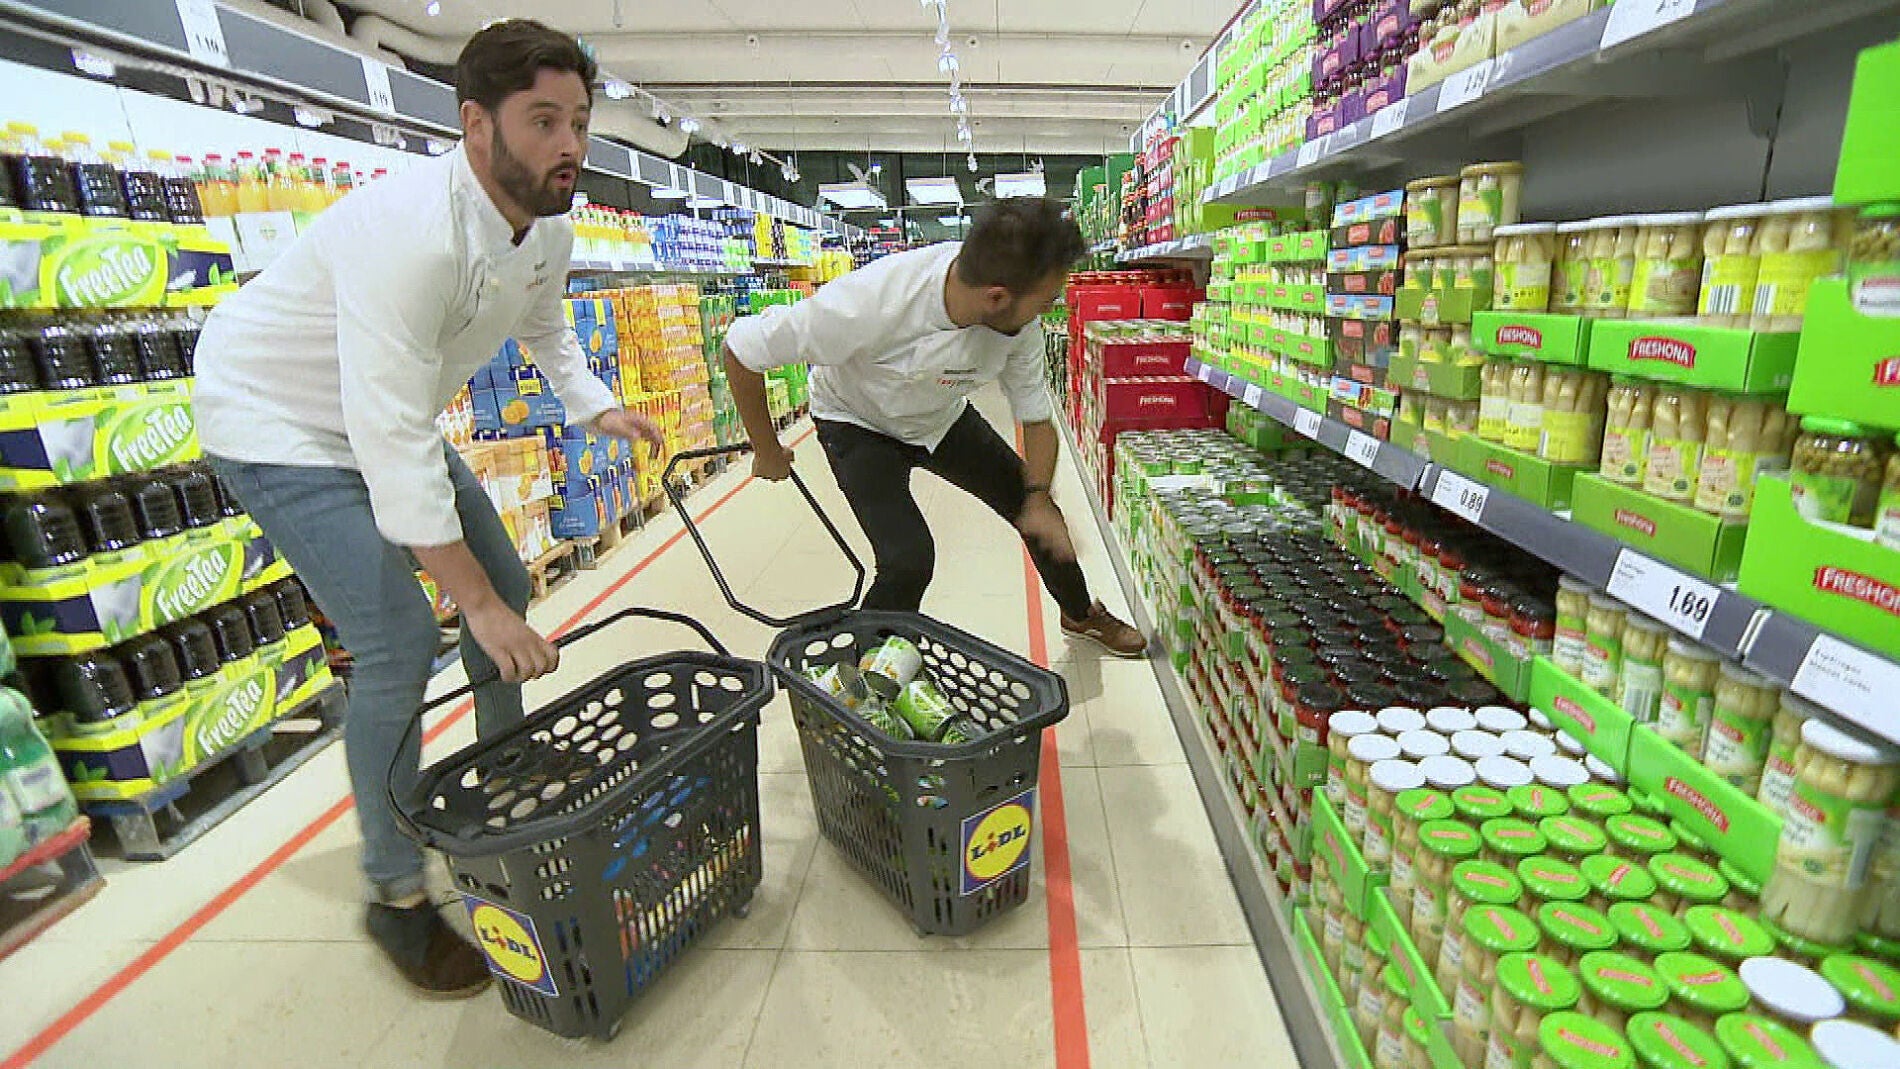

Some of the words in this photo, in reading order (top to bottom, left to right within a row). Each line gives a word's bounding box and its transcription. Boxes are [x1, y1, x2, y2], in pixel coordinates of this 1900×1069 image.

[59, 244, 151, 307] FreeTea
[1498, 326, 1538, 348] FRESHONA
[1632, 339, 1690, 366] FRESHONA
[112, 404, 192, 473] FreeTea
[1460, 488, 1484, 513] 0.89
[155, 547, 229, 621] FreeTea
[1669, 585, 1710, 622] 1.69
[197, 678, 264, 757] FreeTea
